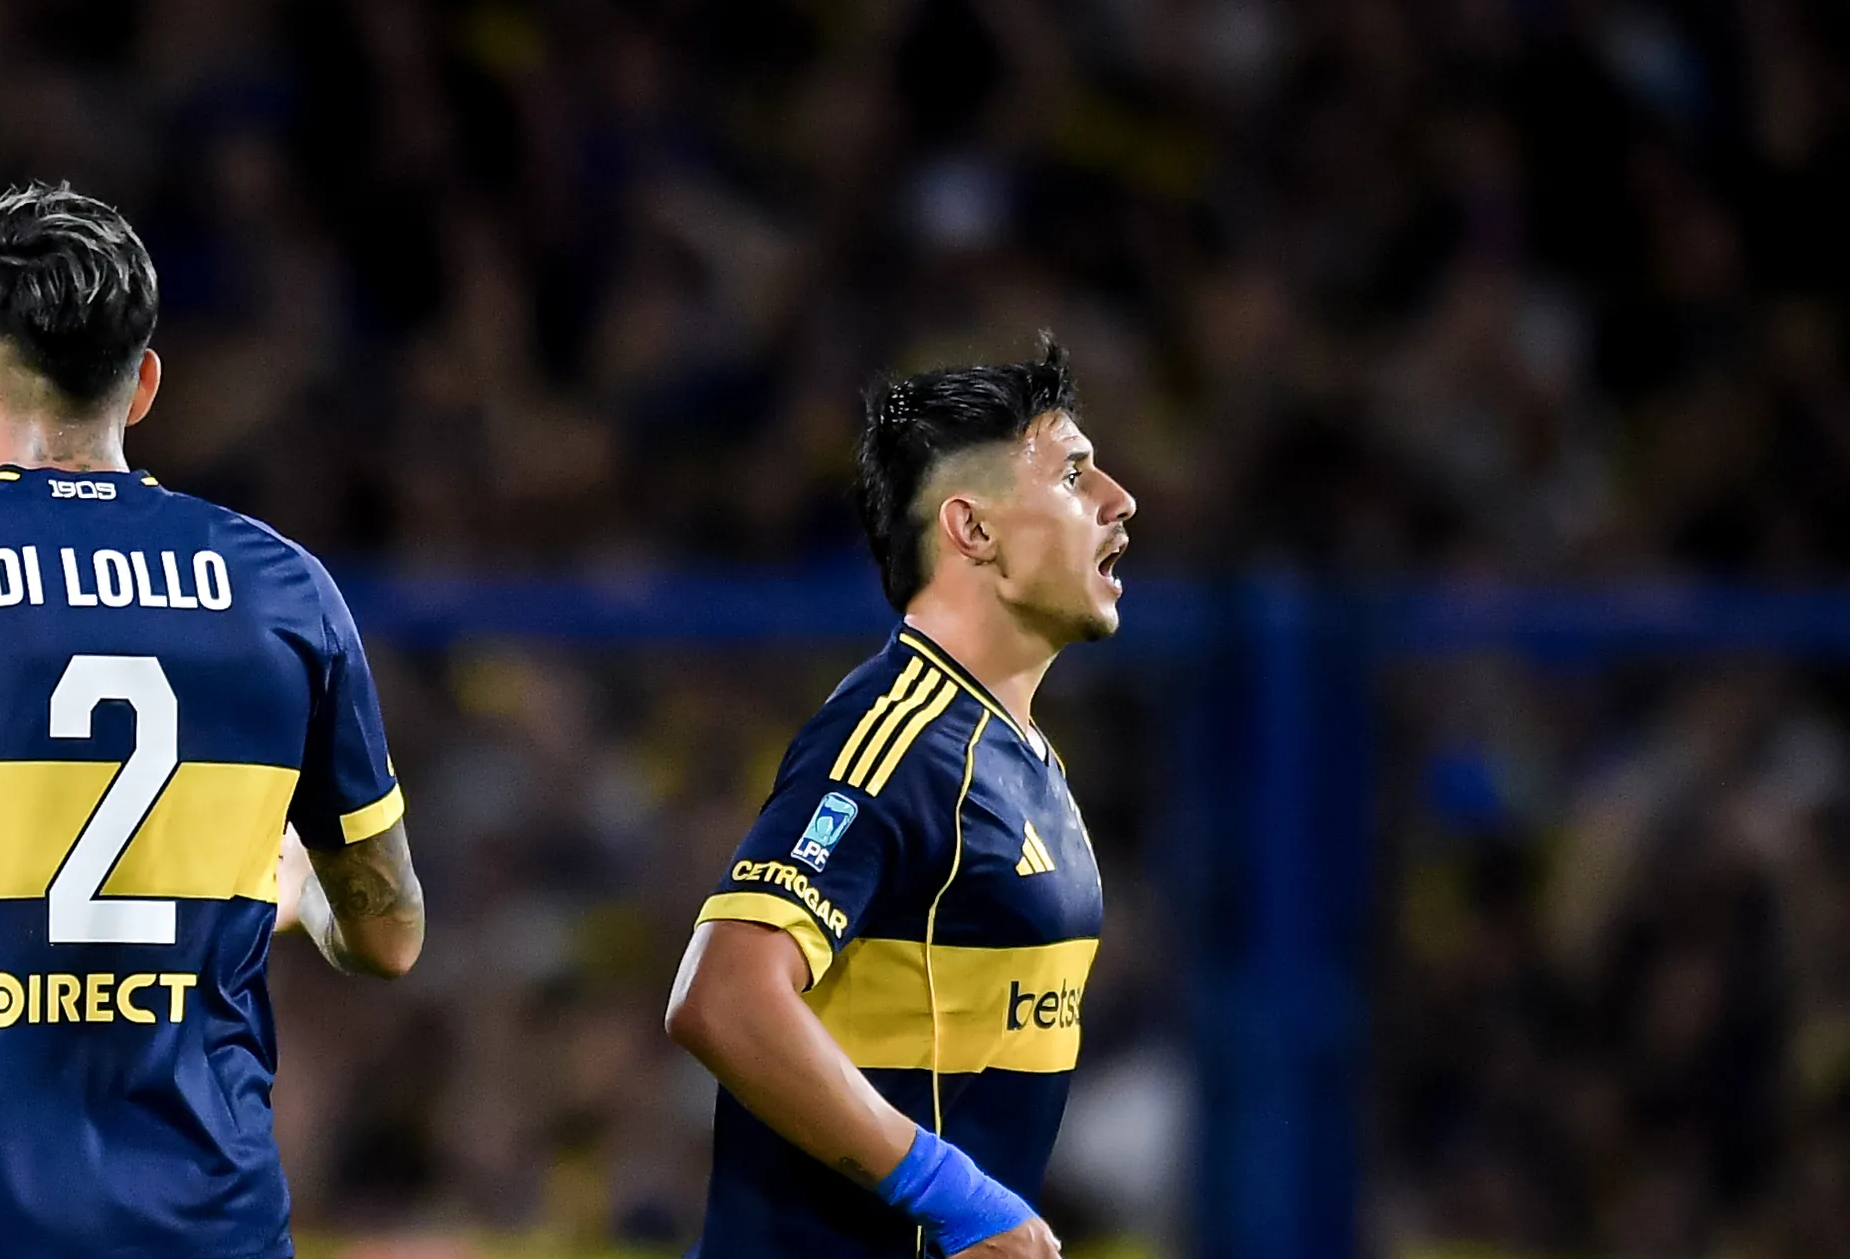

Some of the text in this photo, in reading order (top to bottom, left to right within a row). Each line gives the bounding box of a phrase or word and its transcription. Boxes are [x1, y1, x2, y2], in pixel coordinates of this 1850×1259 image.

[60, 547, 232, 611] LOLLO
[47, 655, 178, 944] 2
[794, 837, 830, 866] LPF
[732, 860, 848, 939] CETROGAR
[1006, 978, 1080, 1031] bets
